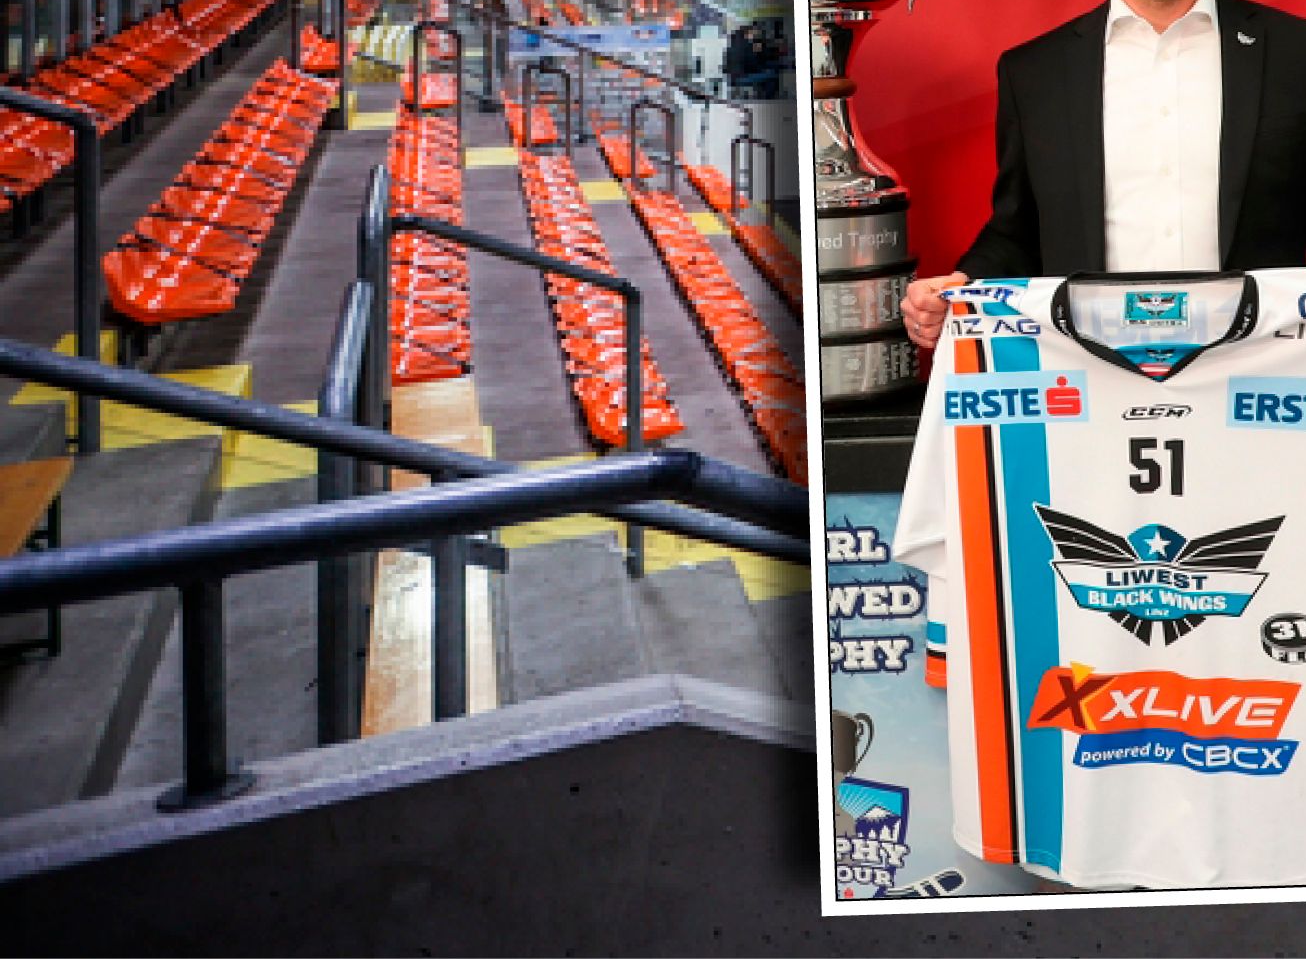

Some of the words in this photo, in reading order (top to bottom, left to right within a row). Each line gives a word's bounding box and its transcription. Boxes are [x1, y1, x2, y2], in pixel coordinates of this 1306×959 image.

[992, 318, 1041, 334] AG
[944, 388, 1041, 420] ERSTE
[1128, 437, 1184, 497] 51
[1106, 570, 1207, 590] LIWEST
[829, 585, 922, 616] WED
[1088, 591, 1153, 606] BLACK
[1159, 592, 1227, 611] WINGS
[830, 639, 909, 670] PHY
[1080, 743, 1150, 763] powered
[1154, 742, 1175, 761] by
[1182, 742, 1283, 768] CBCX
